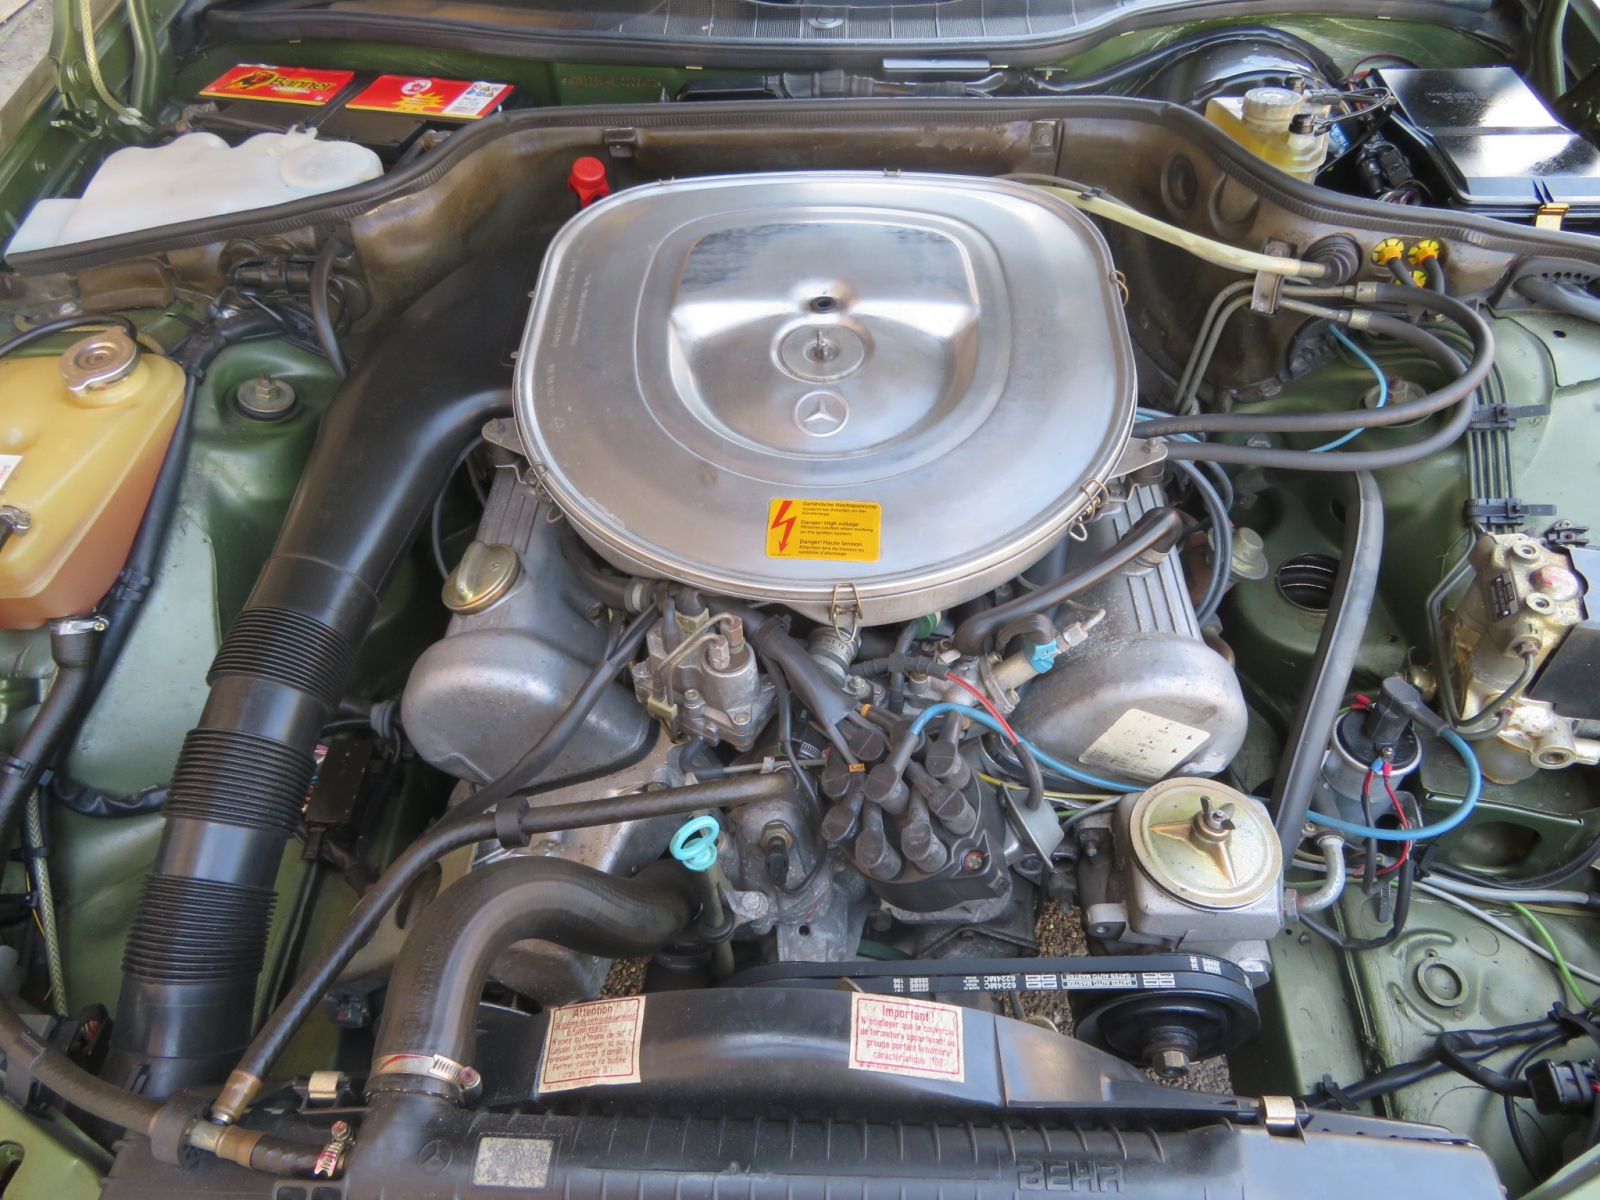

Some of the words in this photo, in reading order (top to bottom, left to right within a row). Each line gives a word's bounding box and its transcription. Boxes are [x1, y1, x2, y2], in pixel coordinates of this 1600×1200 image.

[268, 76, 332, 92] Banner
[573, 1005, 612, 1018] Attention
[882, 1005, 929, 1022] Important
[902, 1022, 913, 1030] que
[915, 1023, 921, 1031] le
[923, 1025, 955, 1036] couvercle
[860, 1028, 868, 1036] de
[870, 1028, 904, 1040] fermeture
[906, 1033, 946, 1045] appartenant
[866, 1039, 890, 1050] groupe
[892, 1042, 916, 1052] portant
[549, 1054, 573, 1064] pression
[585, 1050, 598, 1058] cran
[873, 1051, 925, 1066] caractéristique
[552, 1062, 574, 1071] Fermer
[576, 1059, 596, 1067] contre
[1017, 1160, 1125, 1193] BEHR
